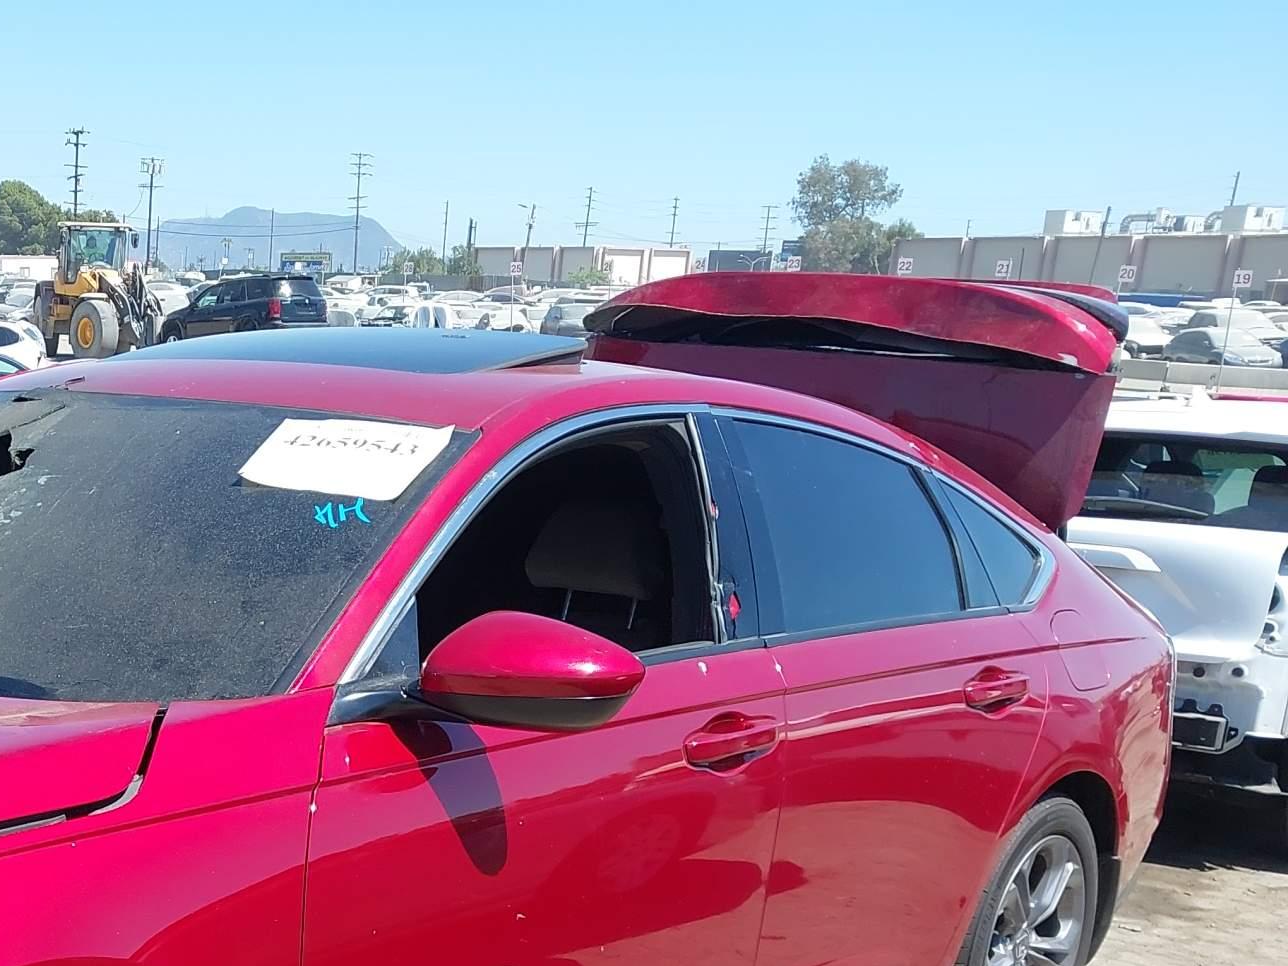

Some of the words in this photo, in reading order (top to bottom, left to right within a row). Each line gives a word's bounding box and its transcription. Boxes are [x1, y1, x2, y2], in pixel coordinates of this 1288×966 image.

[511, 263, 521, 273] 25
[788, 259, 800, 269] 23
[899, 261, 912, 271] 22
[997, 263, 1009, 273] 21
[1120, 268, 1135, 279] 20
[1235, 273, 1251, 284] 19
